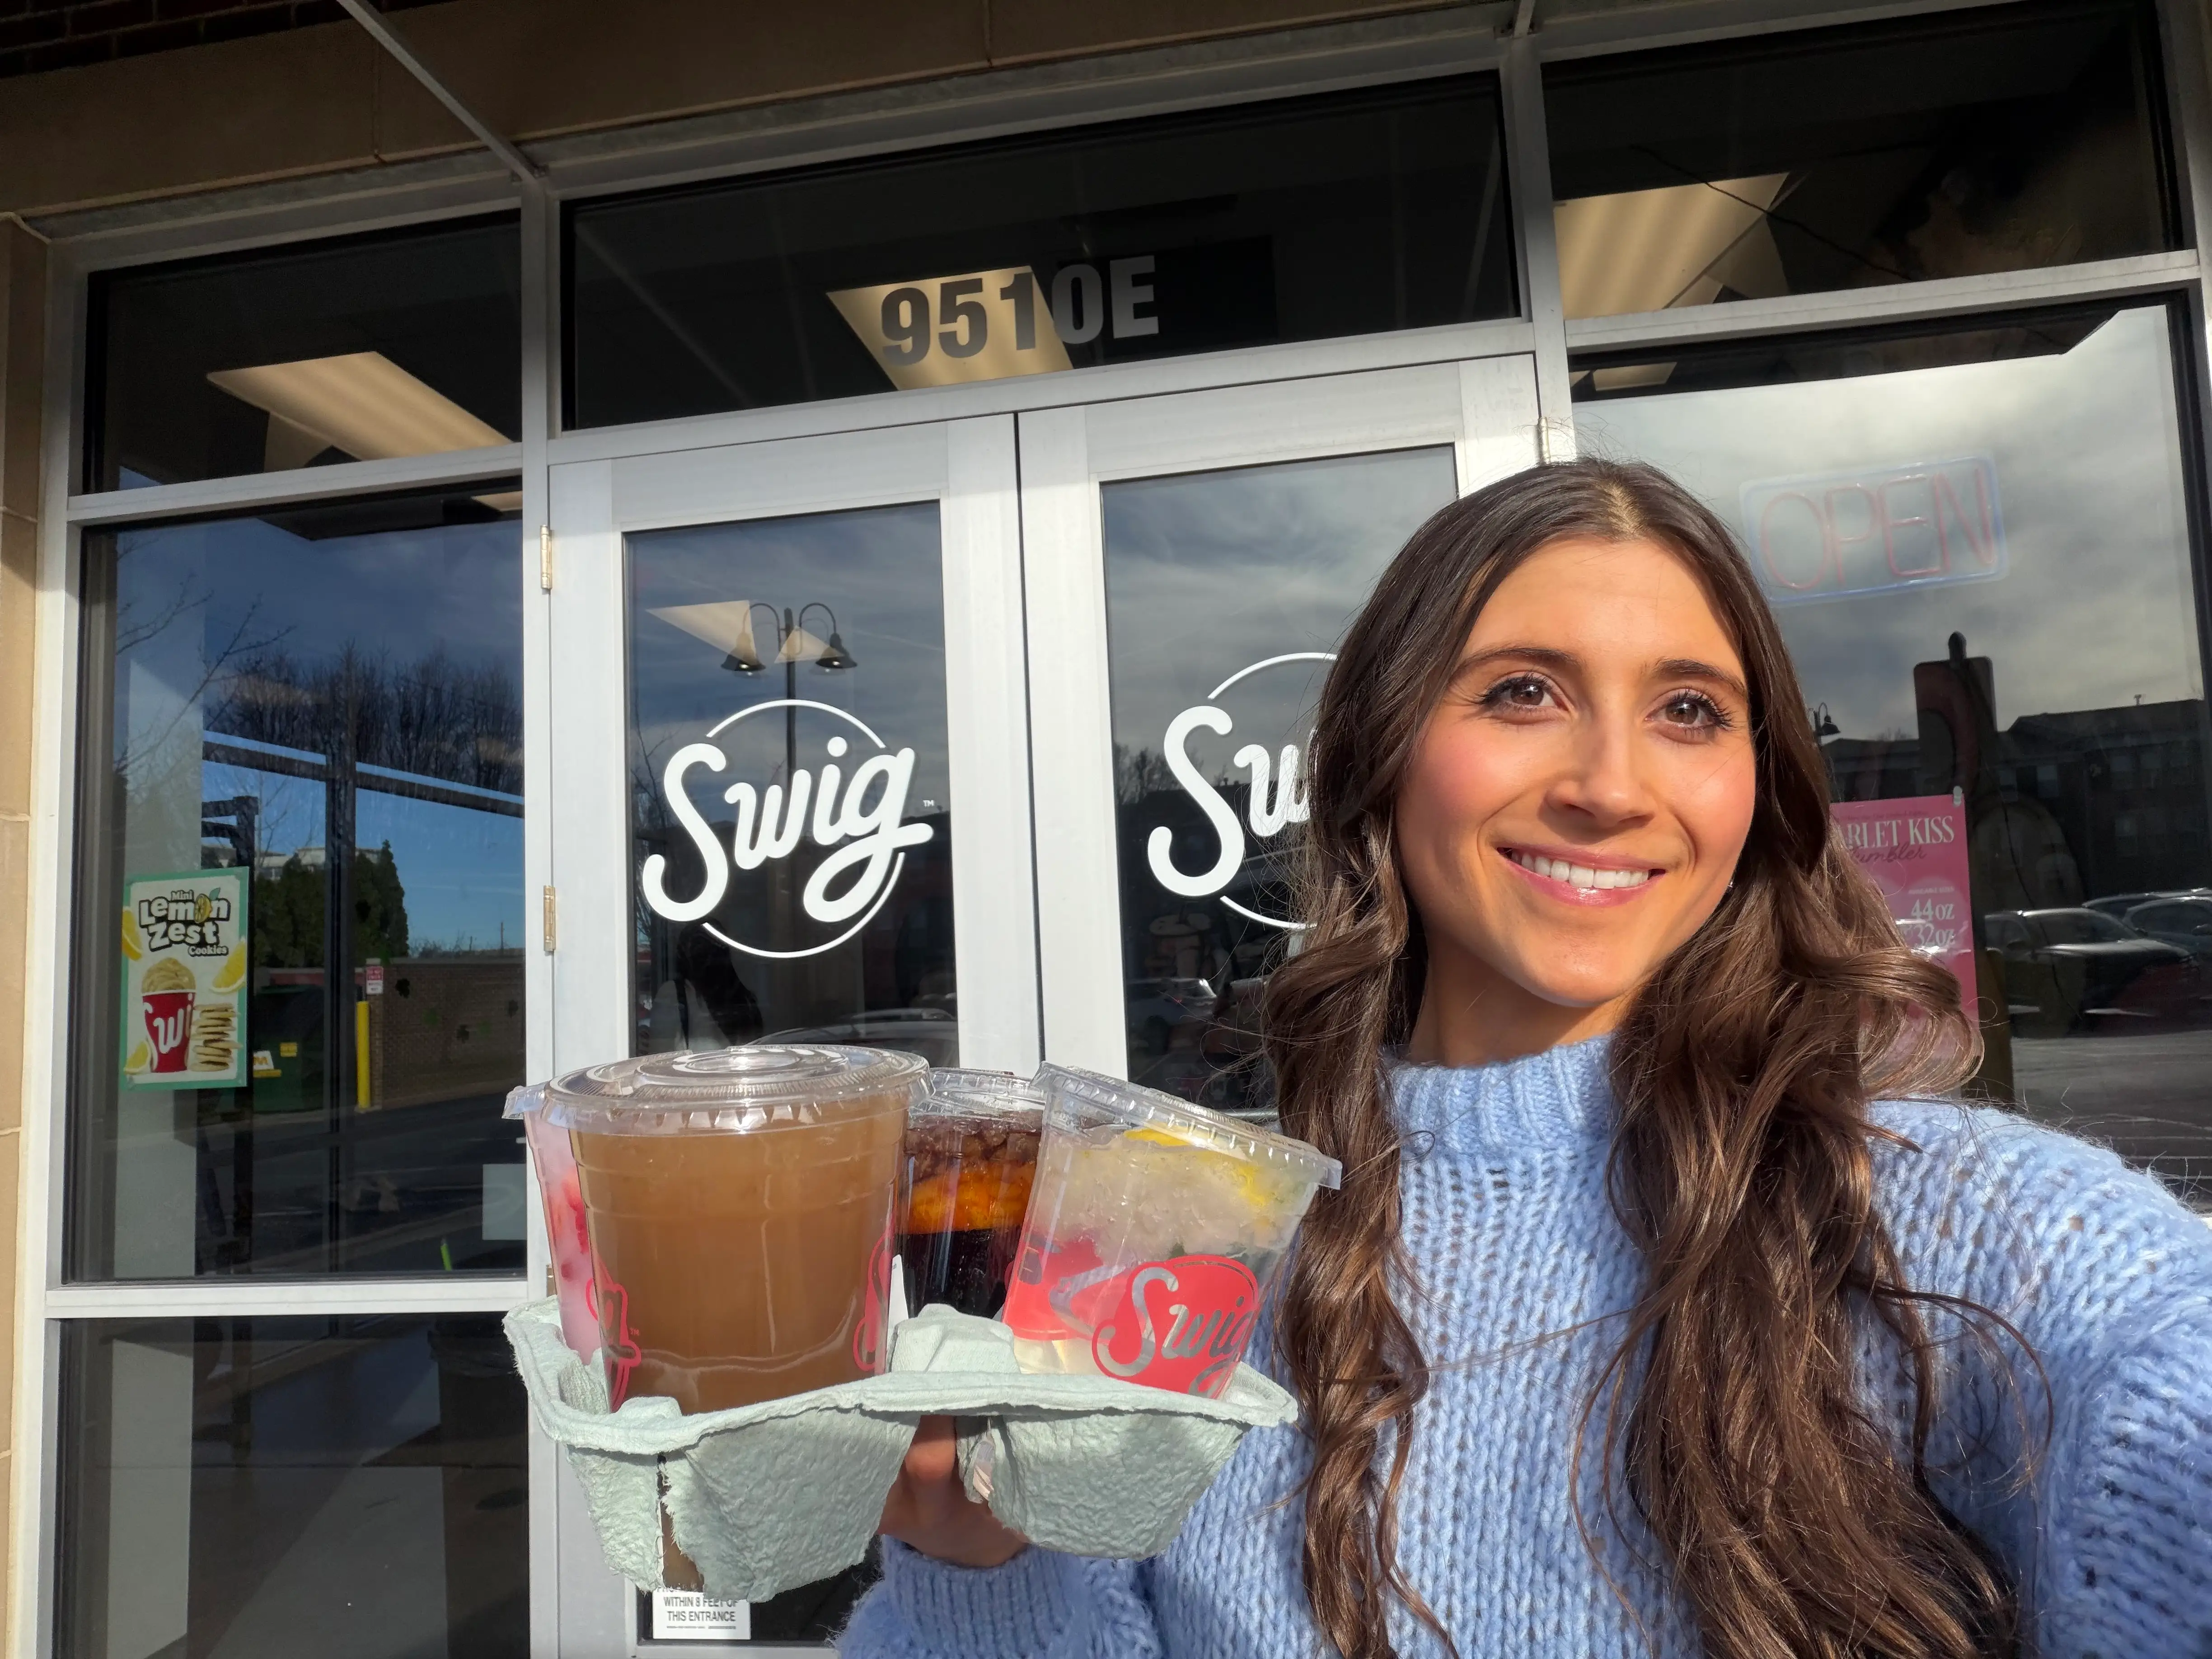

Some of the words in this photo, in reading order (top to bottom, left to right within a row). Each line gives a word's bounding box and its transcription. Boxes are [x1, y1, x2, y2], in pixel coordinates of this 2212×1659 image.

[881, 255, 1159, 367] 9510E
[1761, 467, 1995, 590] OPEN
[642, 736, 933, 922] Swig
[1908, 815, 1955, 845] KISS
[171, 889, 194, 900] Mini
[188, 946, 229, 957] Cookies
[664, 1597, 694, 1607] WITHIN
[667, 1611, 686, 1621] THIS
[689, 1611, 736, 1622] ENTRANCE
